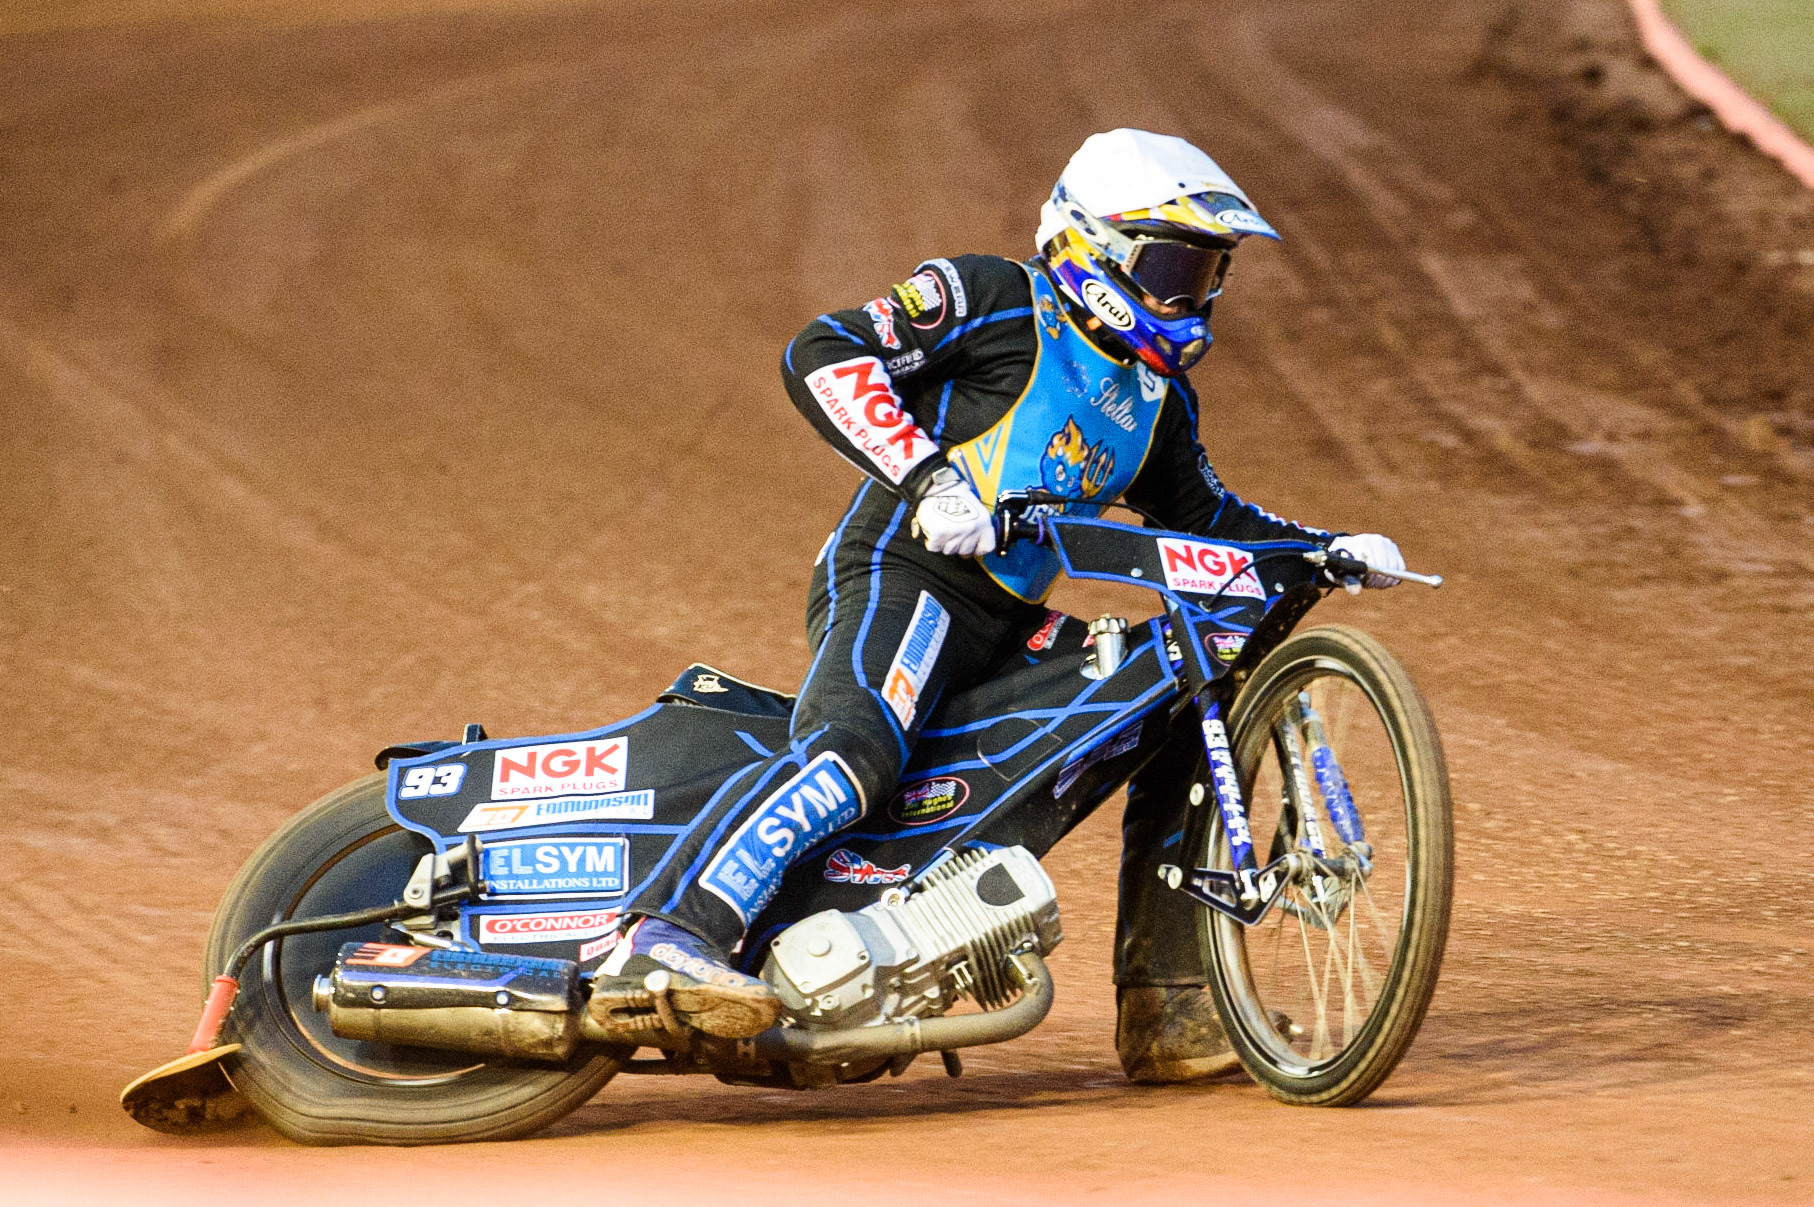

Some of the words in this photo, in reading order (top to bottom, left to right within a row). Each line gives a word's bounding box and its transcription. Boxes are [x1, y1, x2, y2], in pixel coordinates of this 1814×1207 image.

[1090, 287, 1129, 325] Arai
[813, 376, 856, 430] SPARK
[855, 428, 901, 477] PLUGS
[832, 361, 925, 460] NGK
[1164, 544, 1258, 584] NGK
[1173, 577, 1216, 592] SPARK
[500, 744, 620, 783] NGK
[401, 765, 464, 798] 93
[499, 785, 554, 796] SPARK
[561, 780, 619, 791] PLUGS
[717, 769, 848, 901] ELSYM
[489, 845, 615, 875] ELSYM
[592, 876, 619, 888] LTD
[494, 914, 610, 932] O'CONNOR
